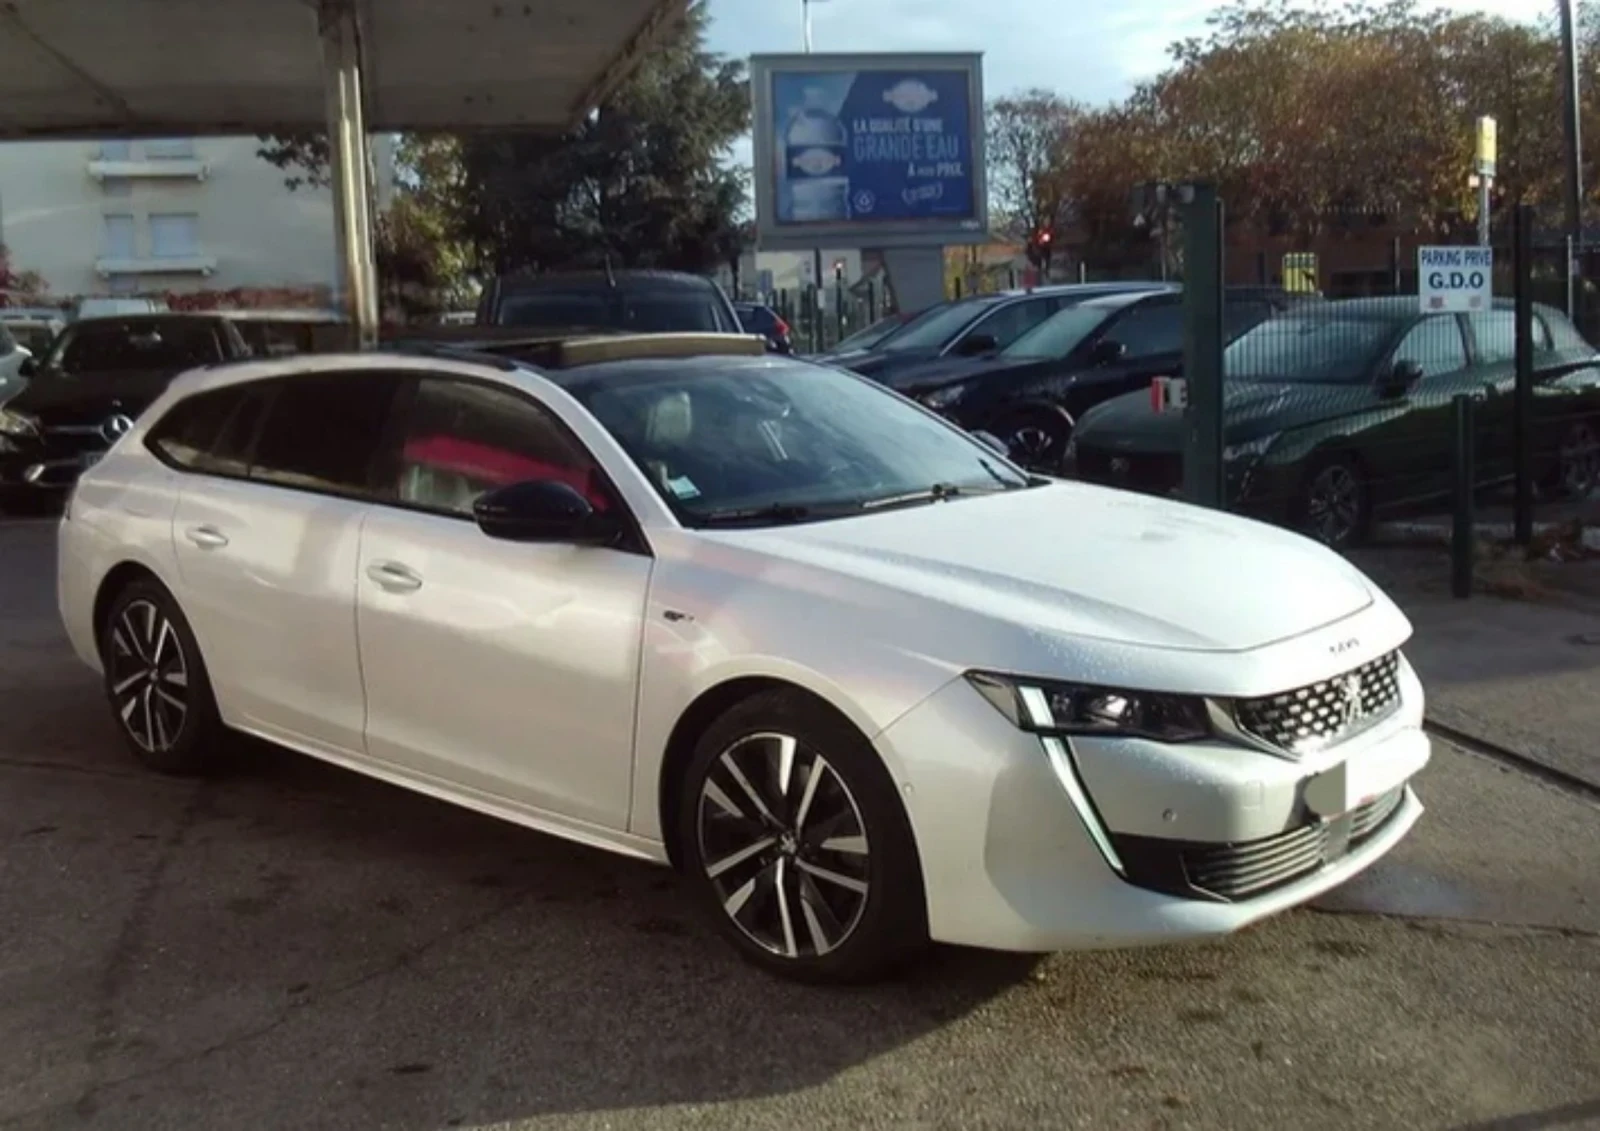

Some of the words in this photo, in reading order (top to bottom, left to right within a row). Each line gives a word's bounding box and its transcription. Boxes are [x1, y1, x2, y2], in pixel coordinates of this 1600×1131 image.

[854, 135, 923, 162] GRANDE
[926, 135, 959, 160] EAU
[1421, 249, 1461, 266] PARKING
[1428, 271, 1484, 289] G.D.O
